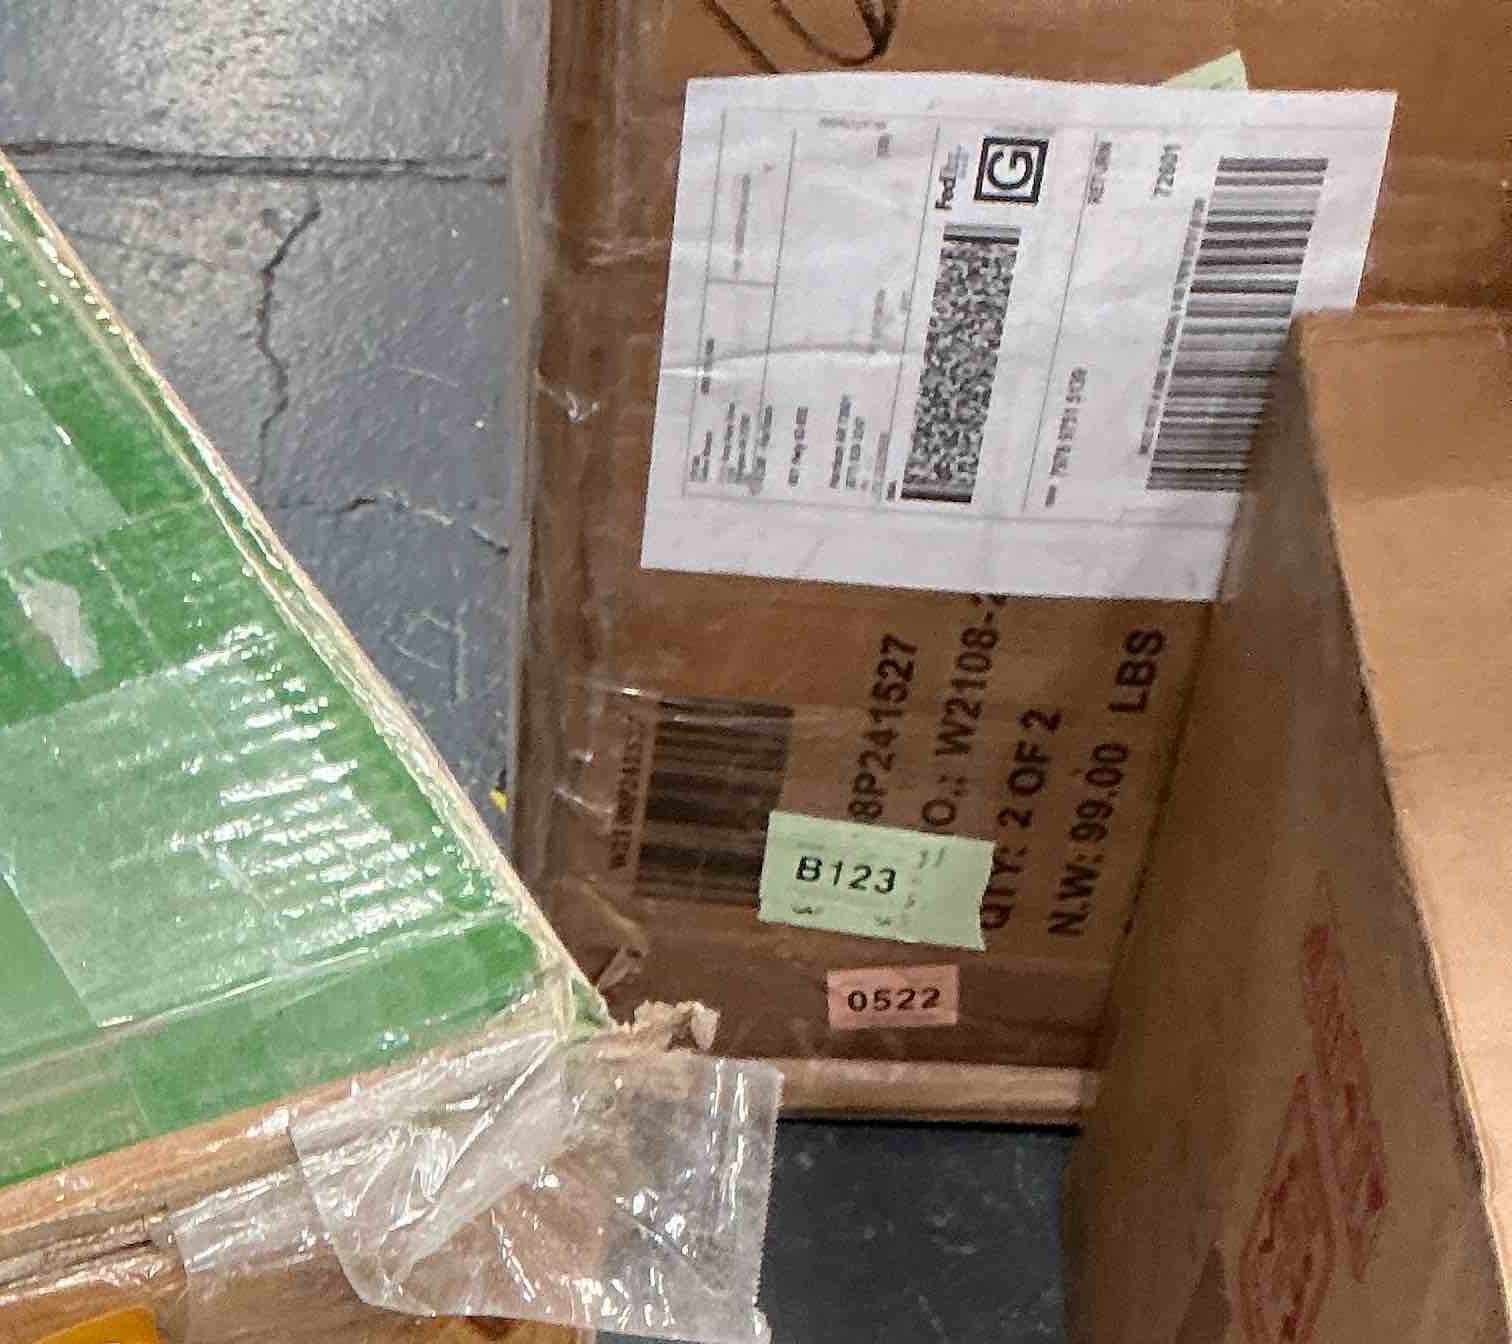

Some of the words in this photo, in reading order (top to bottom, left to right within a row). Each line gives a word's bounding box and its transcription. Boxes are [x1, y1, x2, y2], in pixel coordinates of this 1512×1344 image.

[986, 150, 1035, 191] G
[1019, 708, 1065, 732] 2
[1069, 742, 1130, 844] 99.00
[1107, 628, 1166, 715] LBS
[1006, 739, 1050, 797] OF
[996, 806, 1033, 829] 2
[794, 854, 898, 894] B123
[979, 845, 1028, 931] QTY:
[847, 986, 941, 1012] 0522
